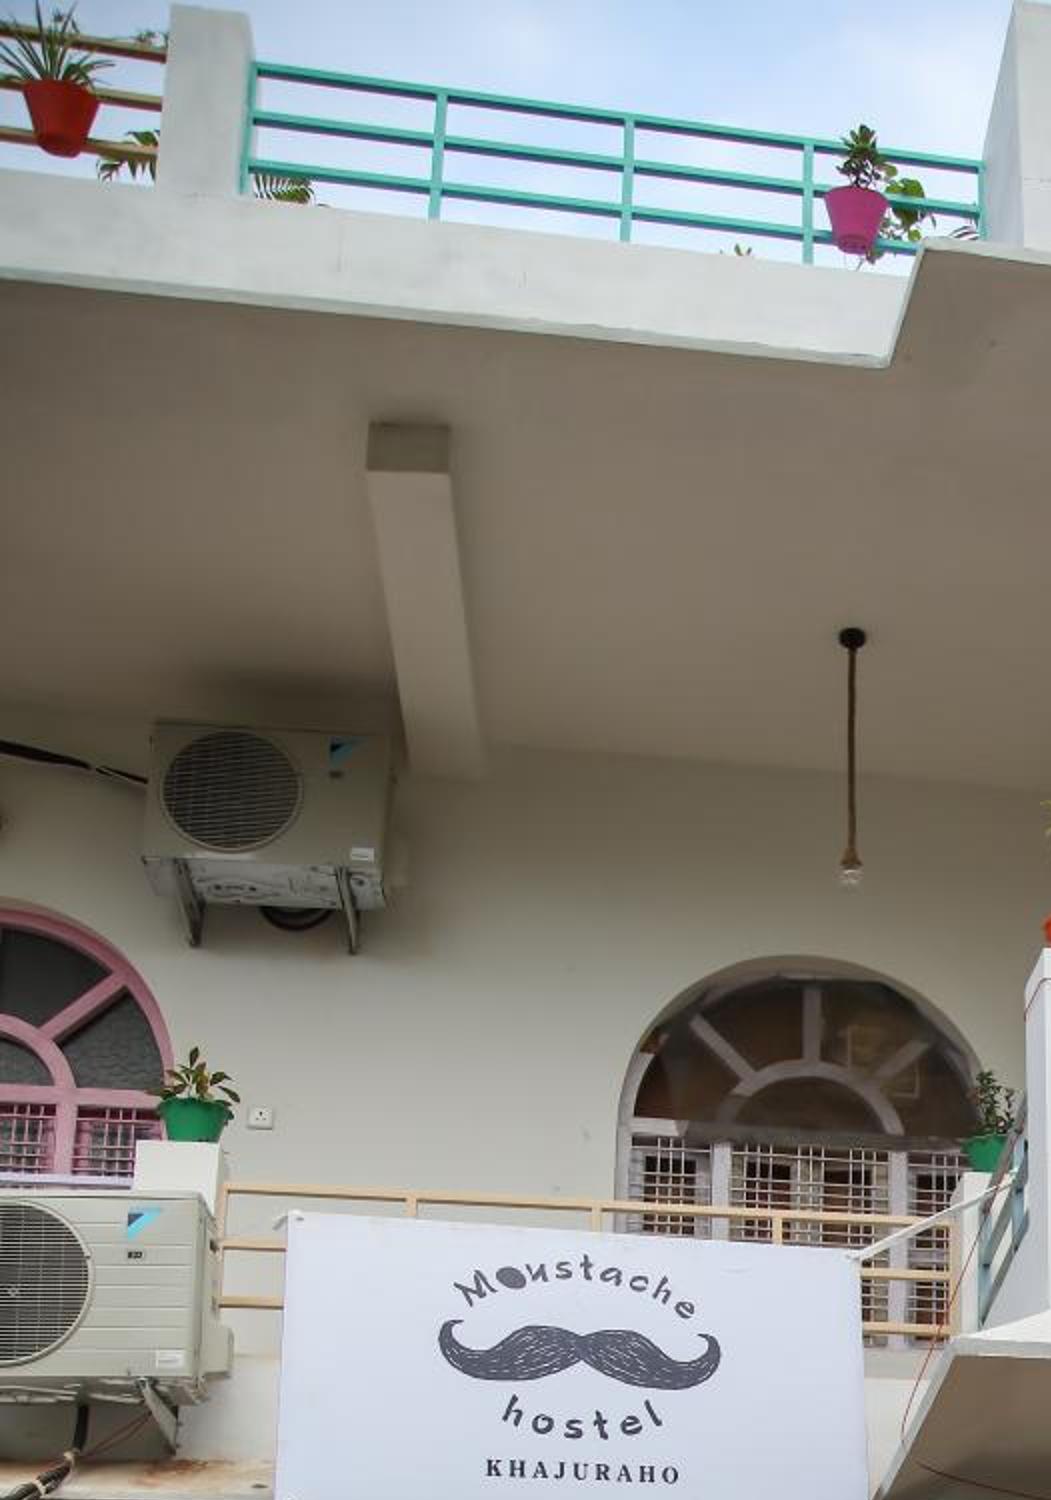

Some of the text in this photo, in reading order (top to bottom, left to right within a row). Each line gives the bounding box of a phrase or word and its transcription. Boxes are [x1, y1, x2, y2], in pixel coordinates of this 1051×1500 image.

[453, 1253, 695, 1319] Moustache
[502, 1394, 663, 1440] hostel
[486, 1459, 679, 1484] KHAJURAHO
